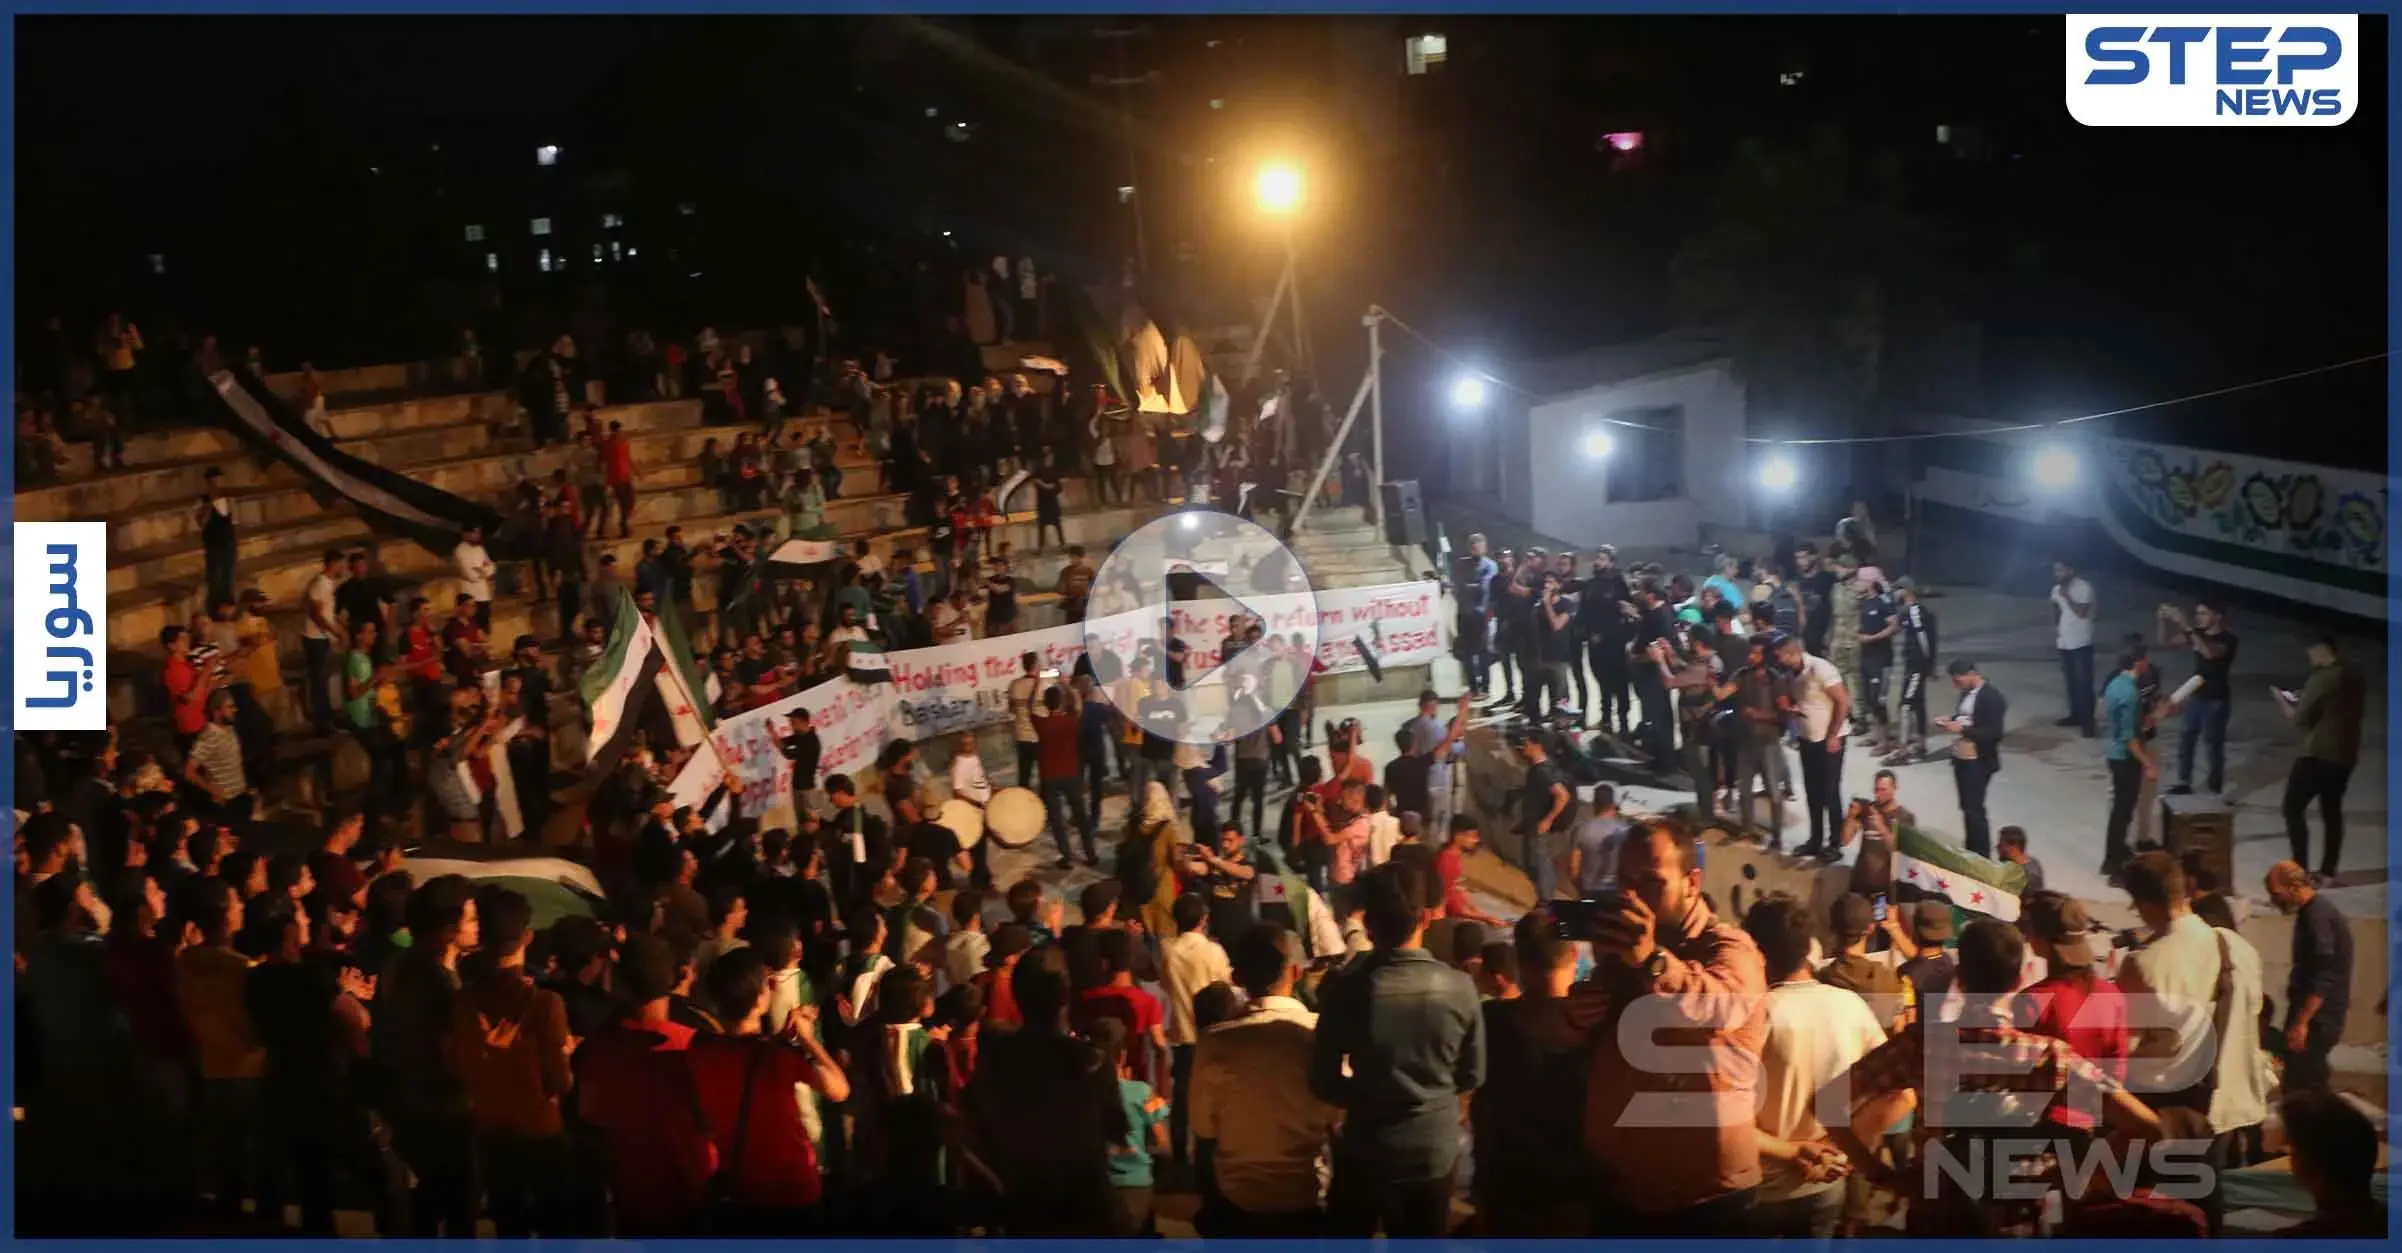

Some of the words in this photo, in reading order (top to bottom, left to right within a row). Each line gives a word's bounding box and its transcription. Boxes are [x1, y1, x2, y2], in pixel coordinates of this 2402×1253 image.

[1352, 594, 1430, 621] without
[892, 660, 978, 694] Holding
[983, 654, 1017, 679] the
